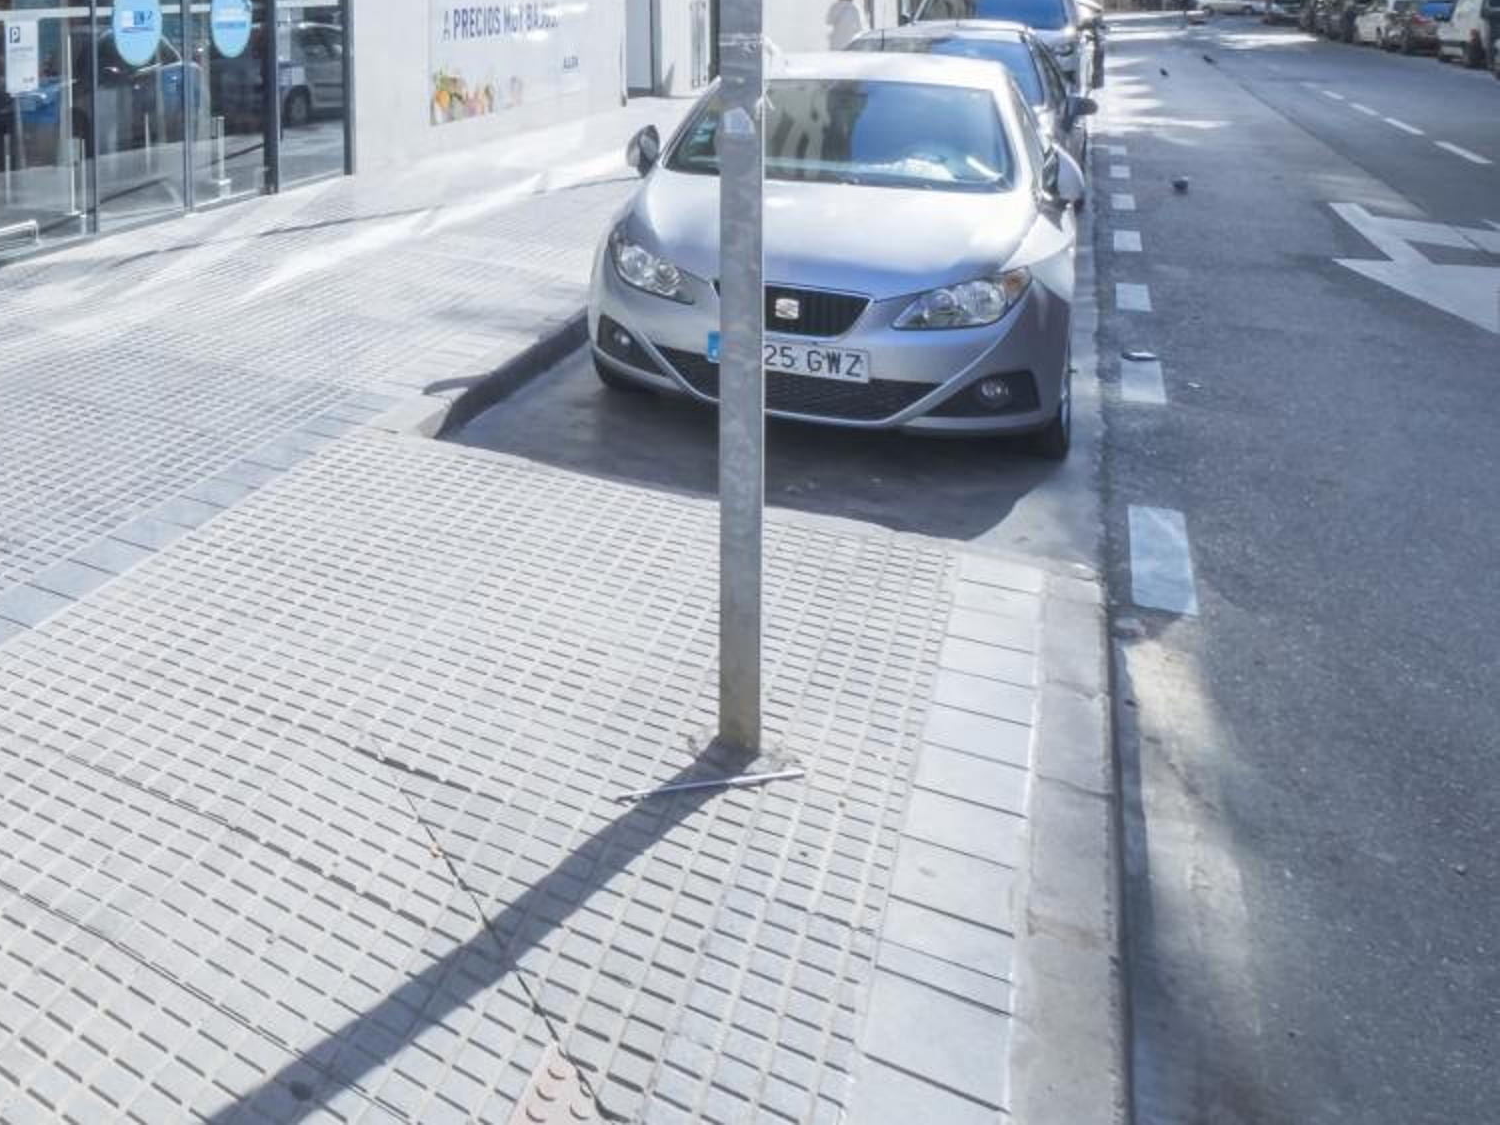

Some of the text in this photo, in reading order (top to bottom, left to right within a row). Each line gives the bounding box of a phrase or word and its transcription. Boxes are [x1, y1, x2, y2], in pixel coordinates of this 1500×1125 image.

[443, 10, 451, 41] A
[453, 6, 501, 40] PRECIOS
[807, 349, 861, 377] GWZ
